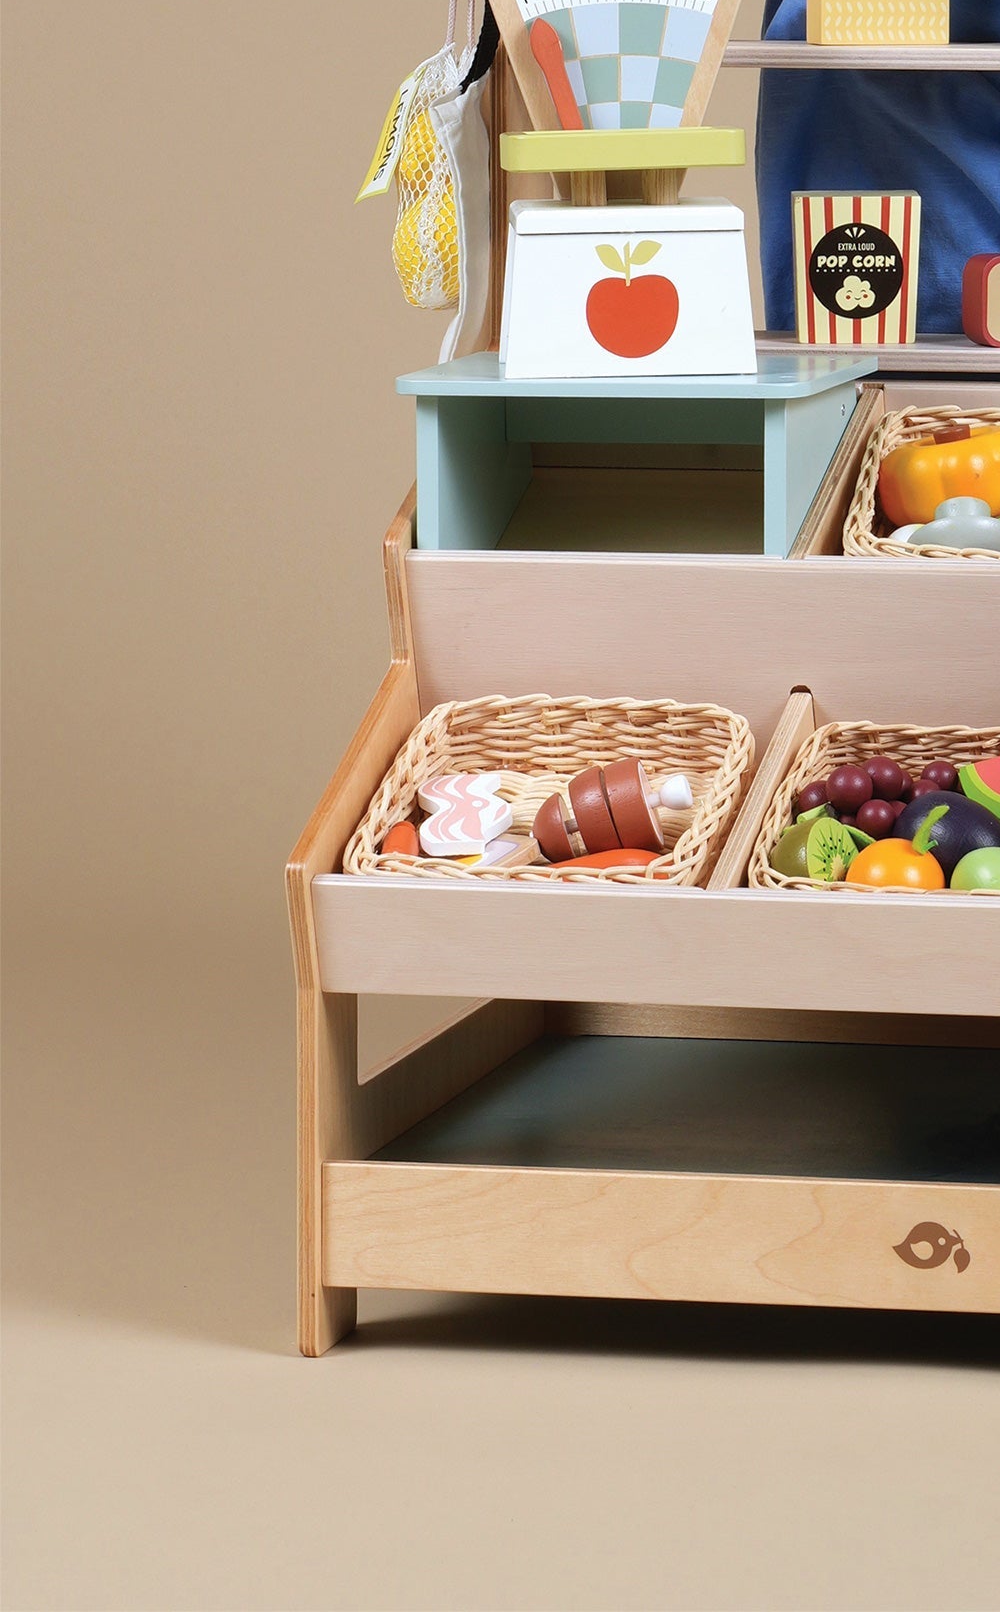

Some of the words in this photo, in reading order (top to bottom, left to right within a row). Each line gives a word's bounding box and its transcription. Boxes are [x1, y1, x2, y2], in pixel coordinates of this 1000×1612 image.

[373, 89, 409, 181] LEMONS
[838, 243, 856, 251] EXTRA
[858, 243, 875, 251] LOUD
[817, 255, 848, 267] POP
[852, 255, 896, 267] CORN
